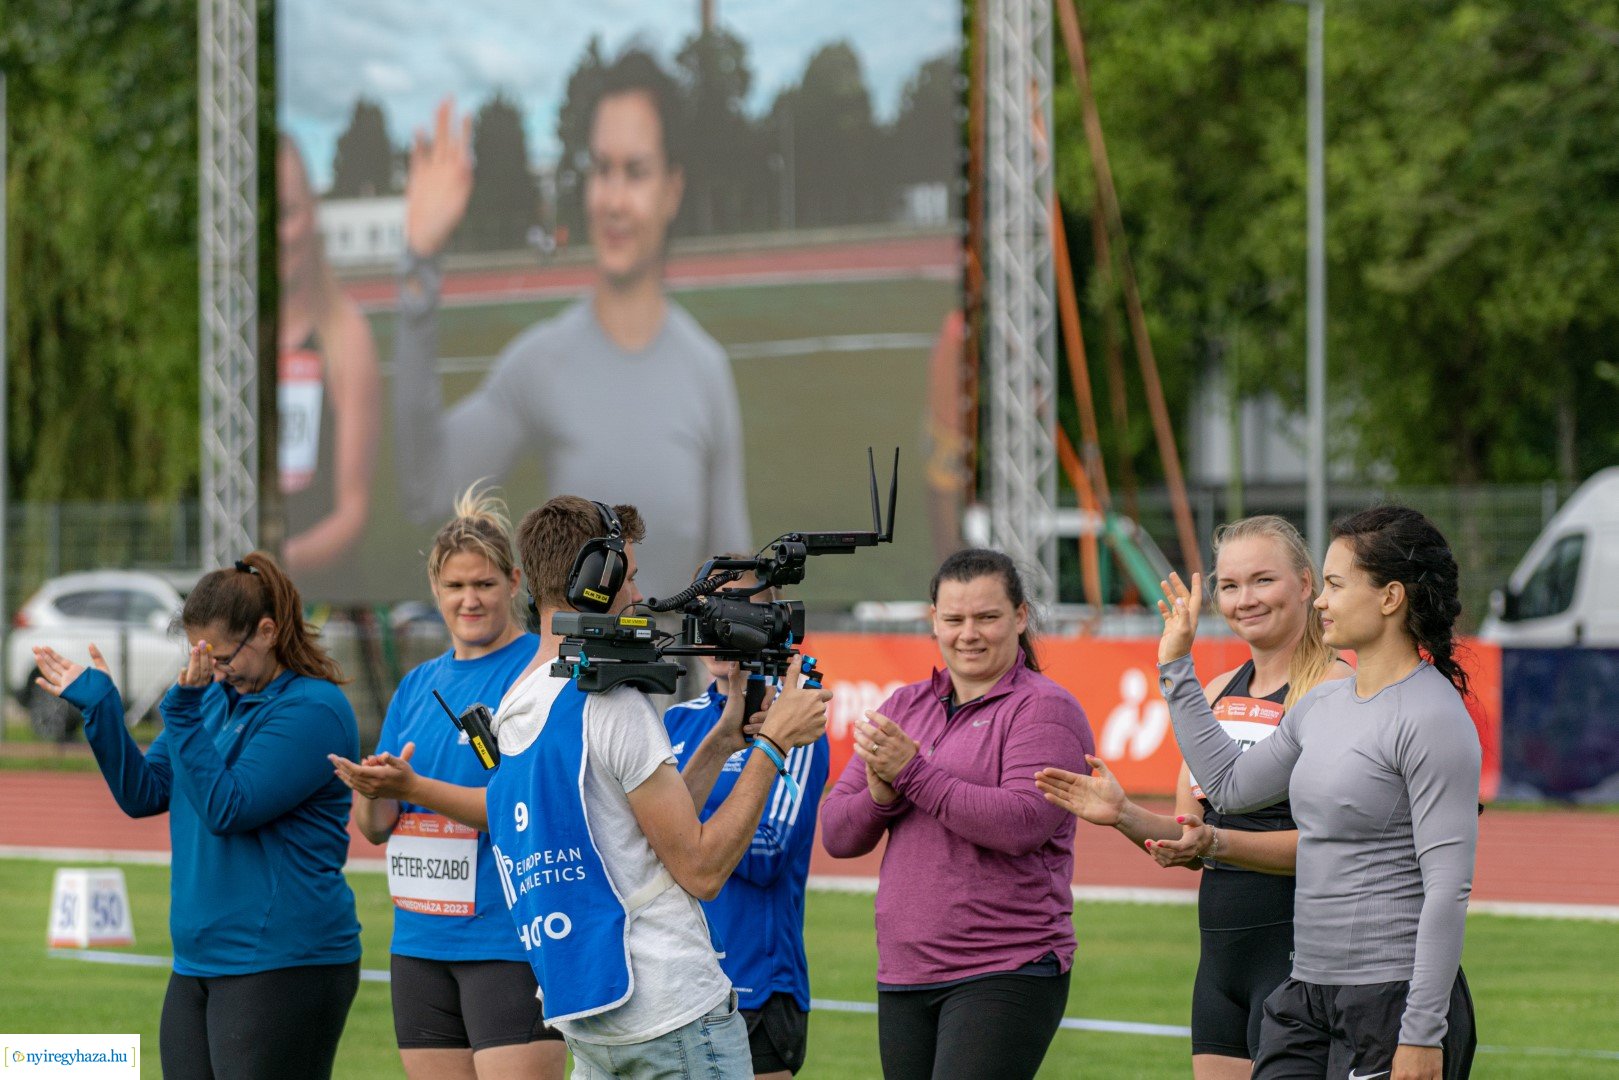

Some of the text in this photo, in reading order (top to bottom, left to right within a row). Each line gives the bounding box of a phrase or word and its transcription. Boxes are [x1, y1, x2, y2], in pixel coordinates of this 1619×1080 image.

[514, 801, 529, 832] 9
[391, 852, 469, 880] PÉTER-SZABÓ
[91, 891, 123, 930] 50
[443, 903, 469, 914] 2023
